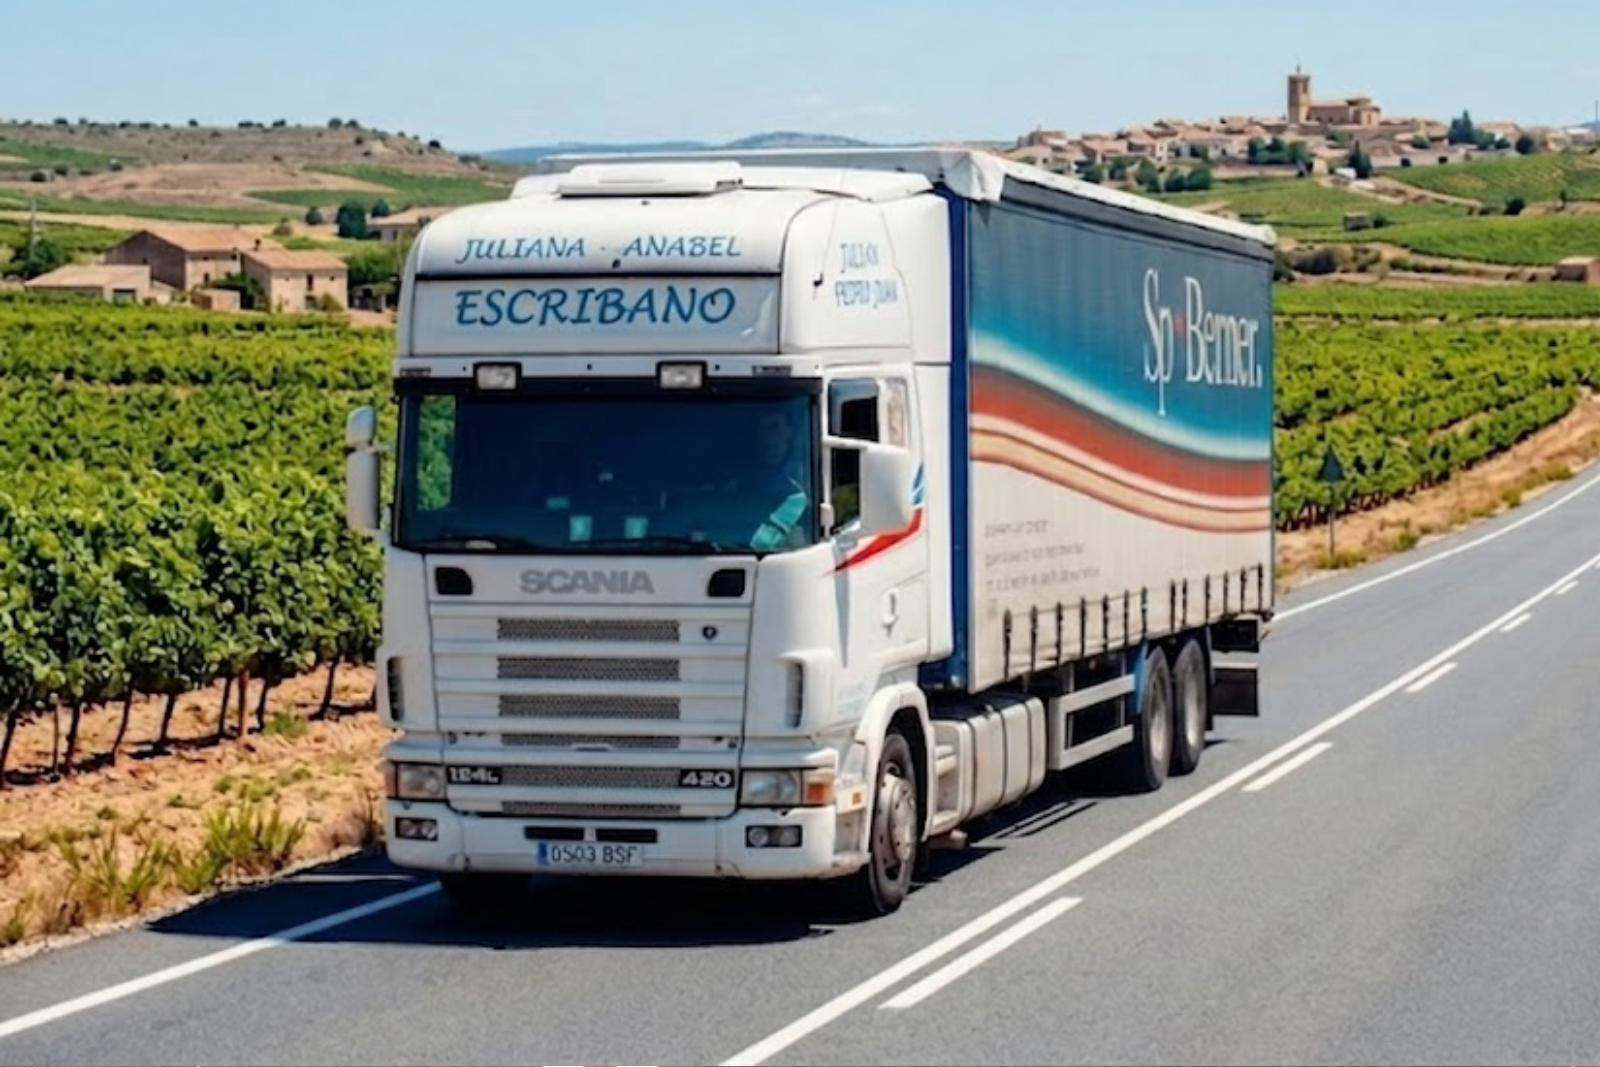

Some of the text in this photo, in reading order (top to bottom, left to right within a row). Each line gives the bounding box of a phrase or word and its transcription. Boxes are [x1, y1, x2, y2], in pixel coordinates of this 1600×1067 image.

[455, 235, 741, 264] JULIANA ANABEL
[455, 285, 736, 326] ESCRIBANO
[1143, 268, 1175, 417] Sp
[519, 568, 656, 595] SCANIA
[682, 771, 732, 787] 420
